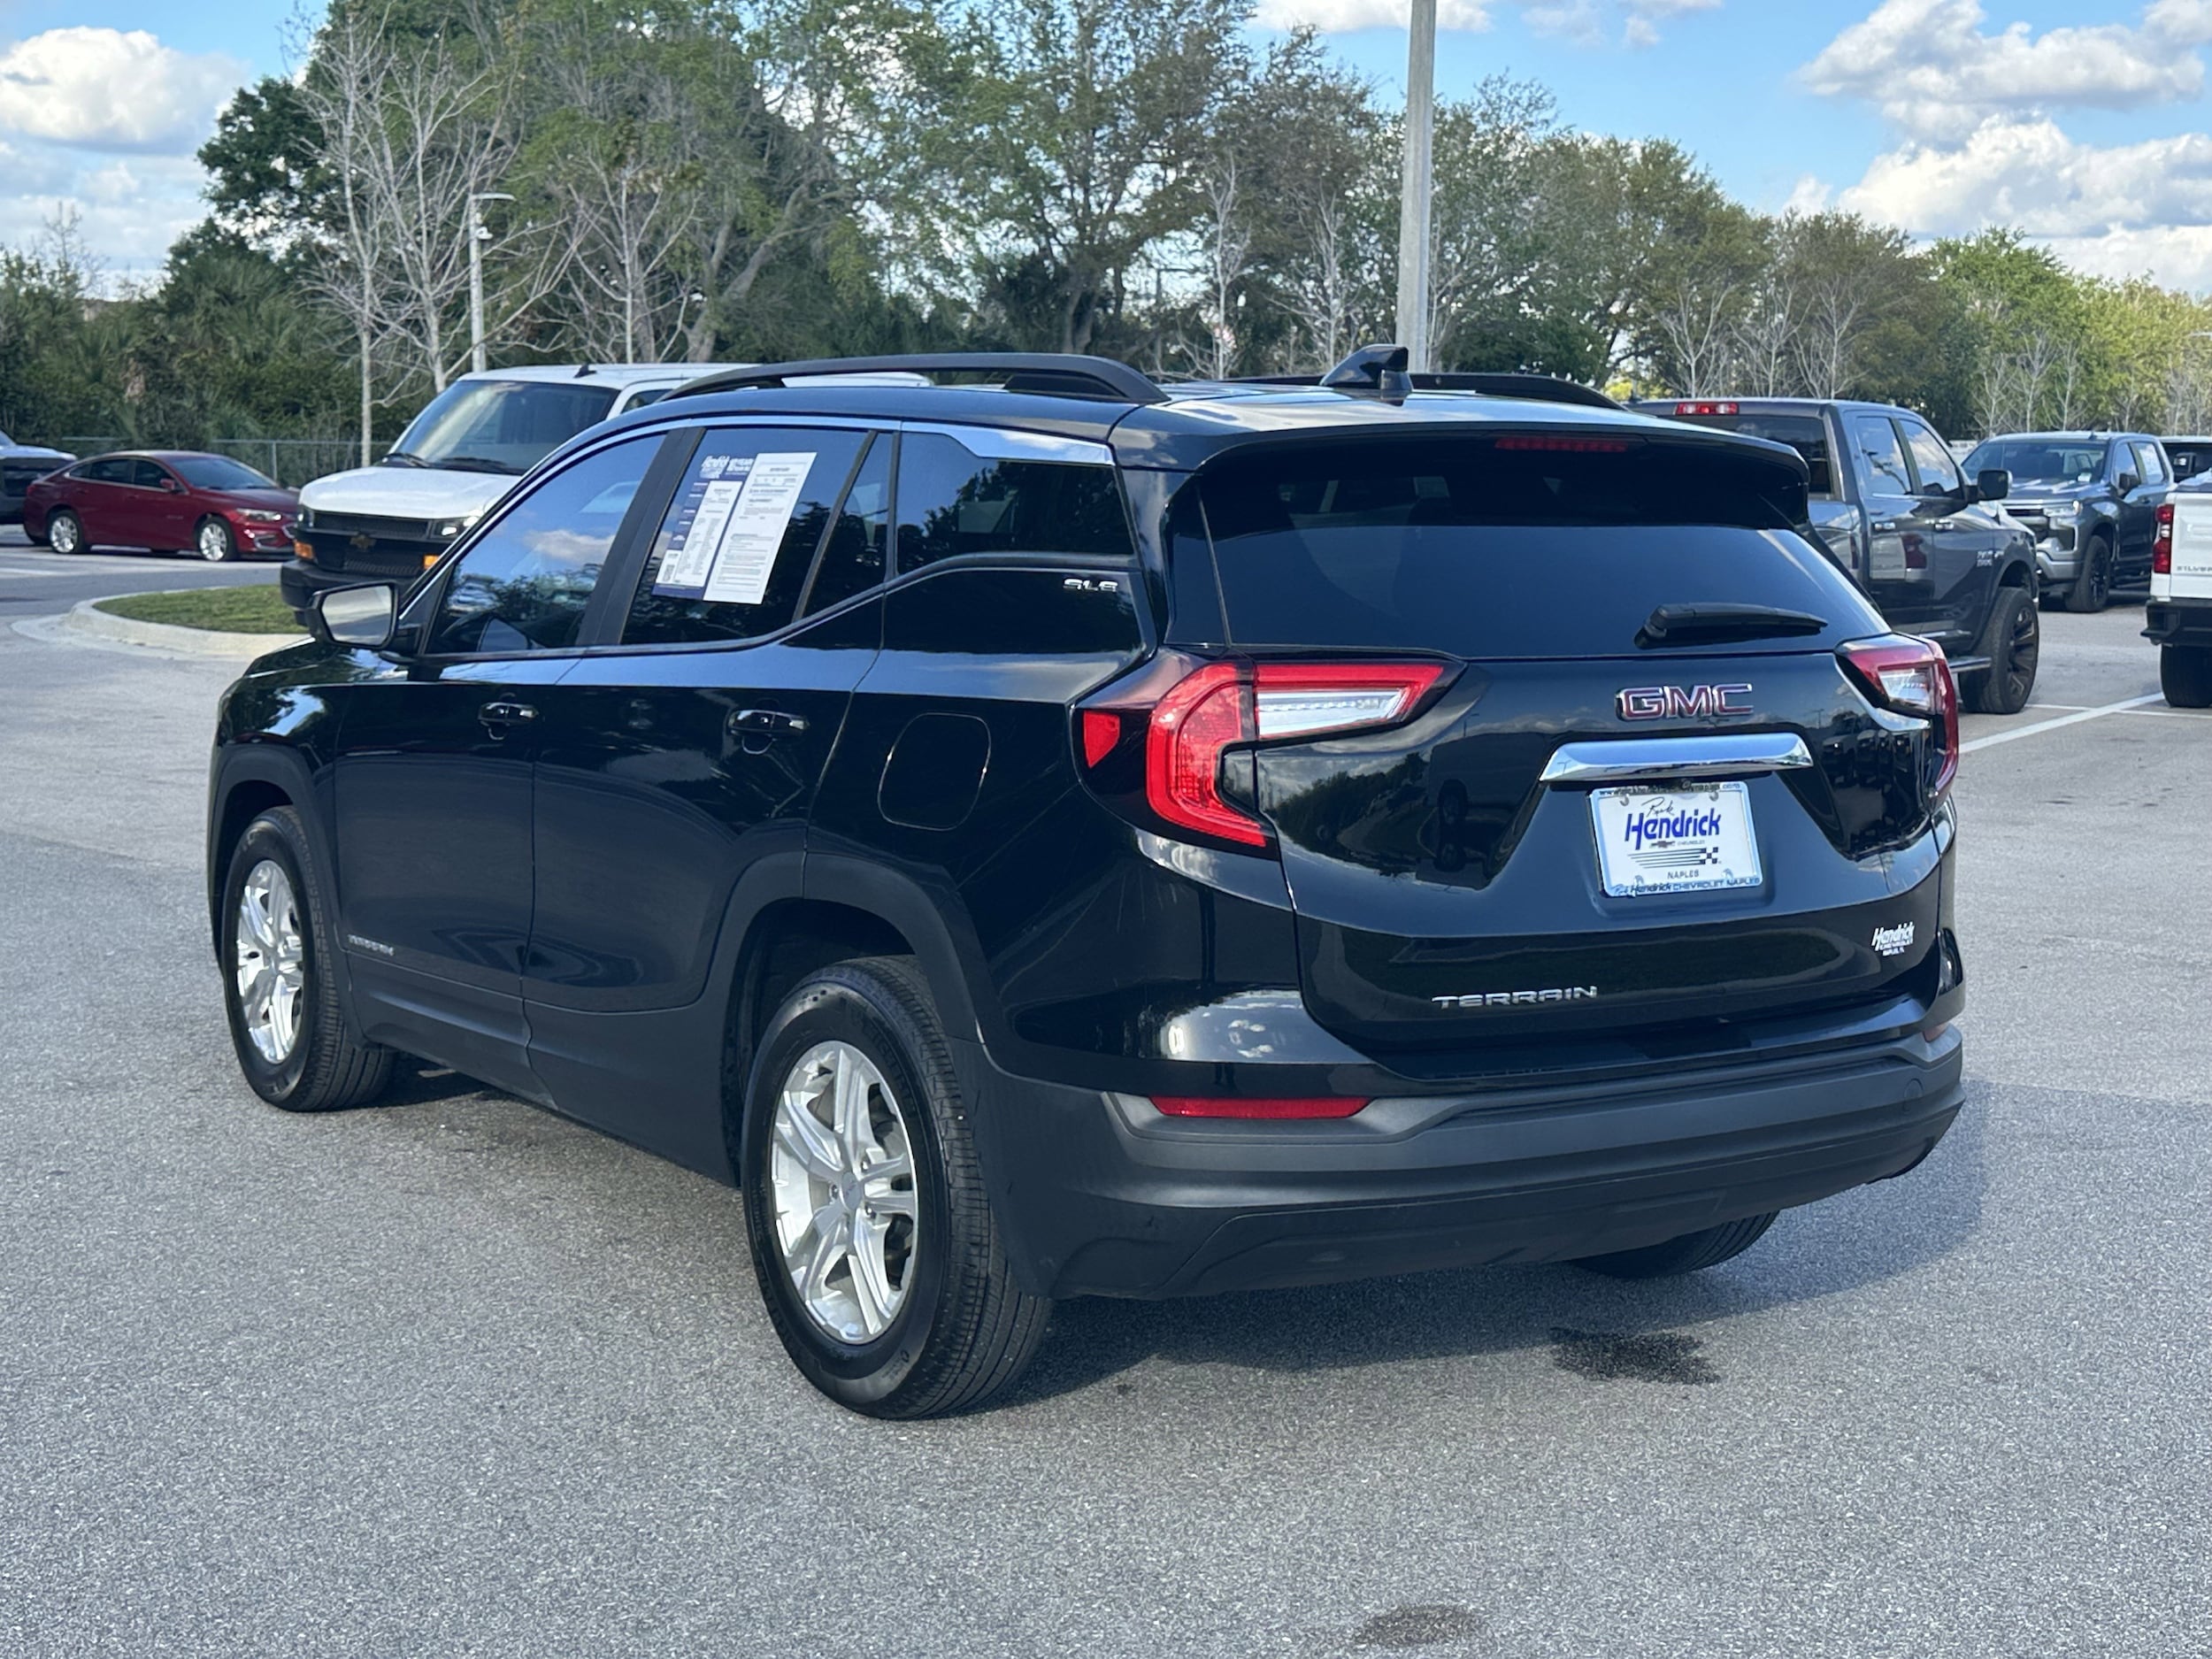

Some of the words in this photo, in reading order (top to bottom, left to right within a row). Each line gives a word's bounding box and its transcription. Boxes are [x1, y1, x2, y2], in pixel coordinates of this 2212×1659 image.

[1615, 683, 1755, 721] GMC
[1624, 808, 1721, 850] Hendrick
[1630, 882, 1672, 895] Hendrick
[1673, 879, 1724, 891] CHEVROLET
[1726, 877, 1760, 887] NAPLES
[1667, 869, 1700, 879] NAPLES
[1871, 921, 1915, 951] Hendrick
[1431, 985, 1599, 1010] TERRAIN
